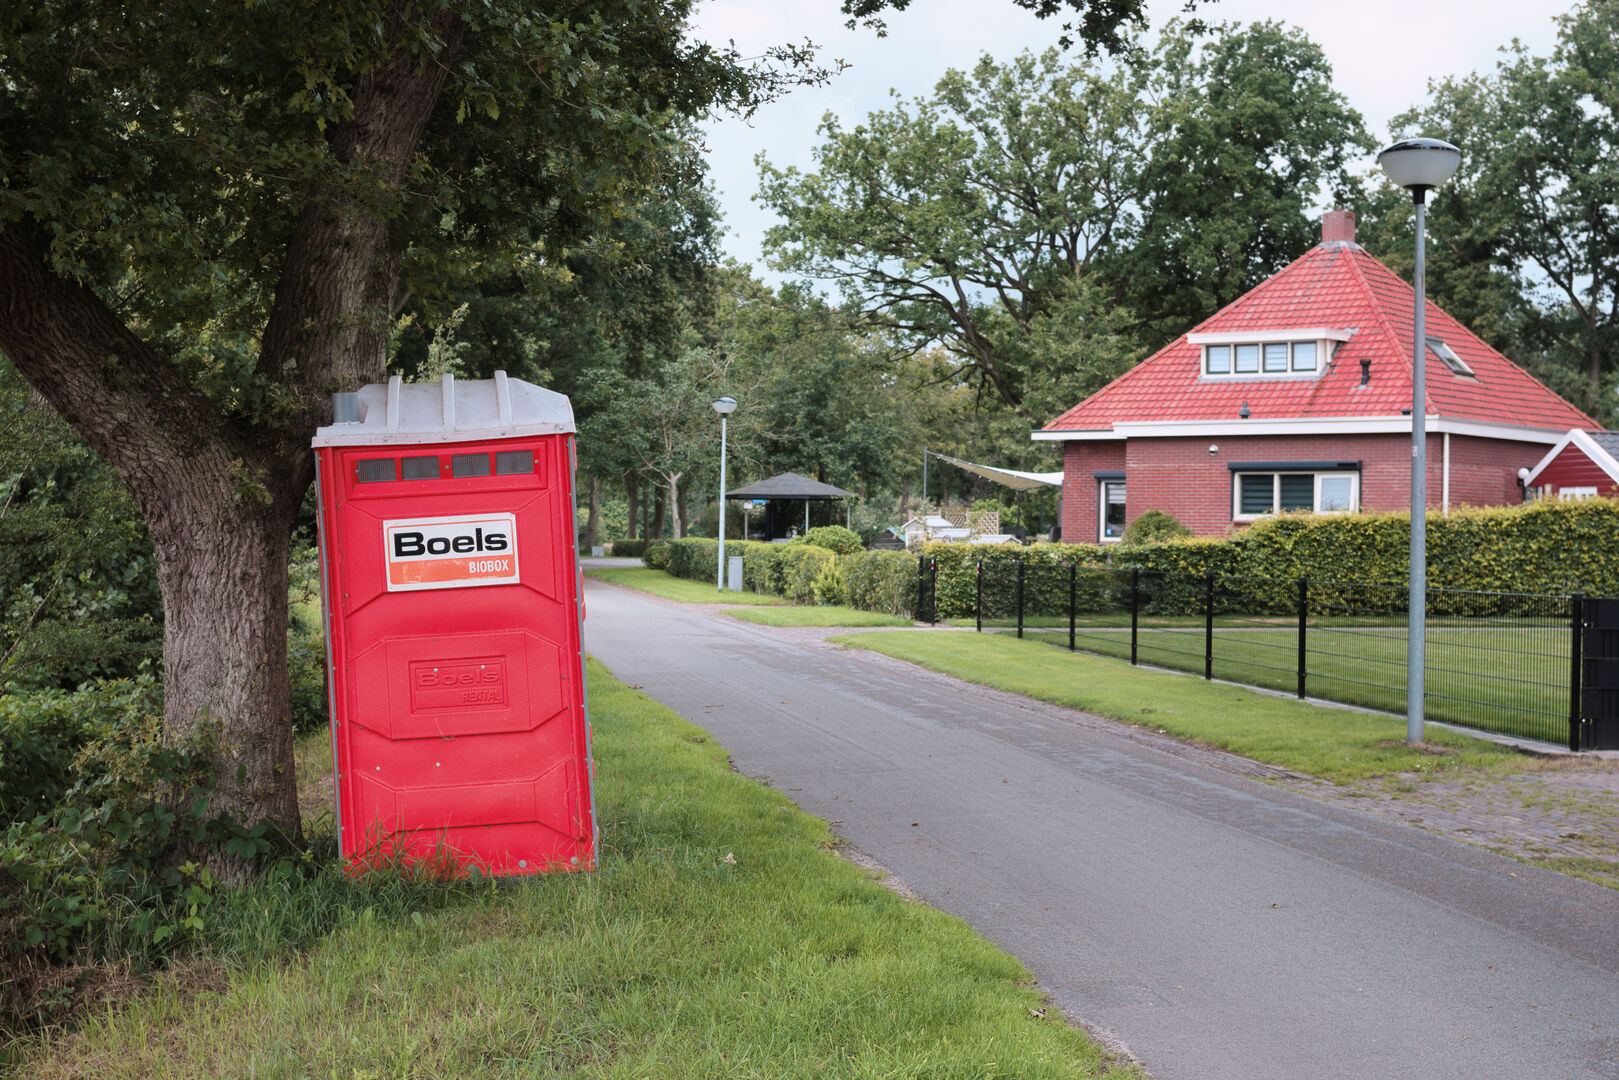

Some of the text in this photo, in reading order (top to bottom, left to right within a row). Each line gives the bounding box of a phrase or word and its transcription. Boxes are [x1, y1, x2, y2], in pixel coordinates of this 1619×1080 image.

[394, 528, 508, 557] Boels
[469, 559, 509, 574] BIOBOX
[418, 669, 500, 688] Boels
[463, 690, 502, 703] RENTAL
